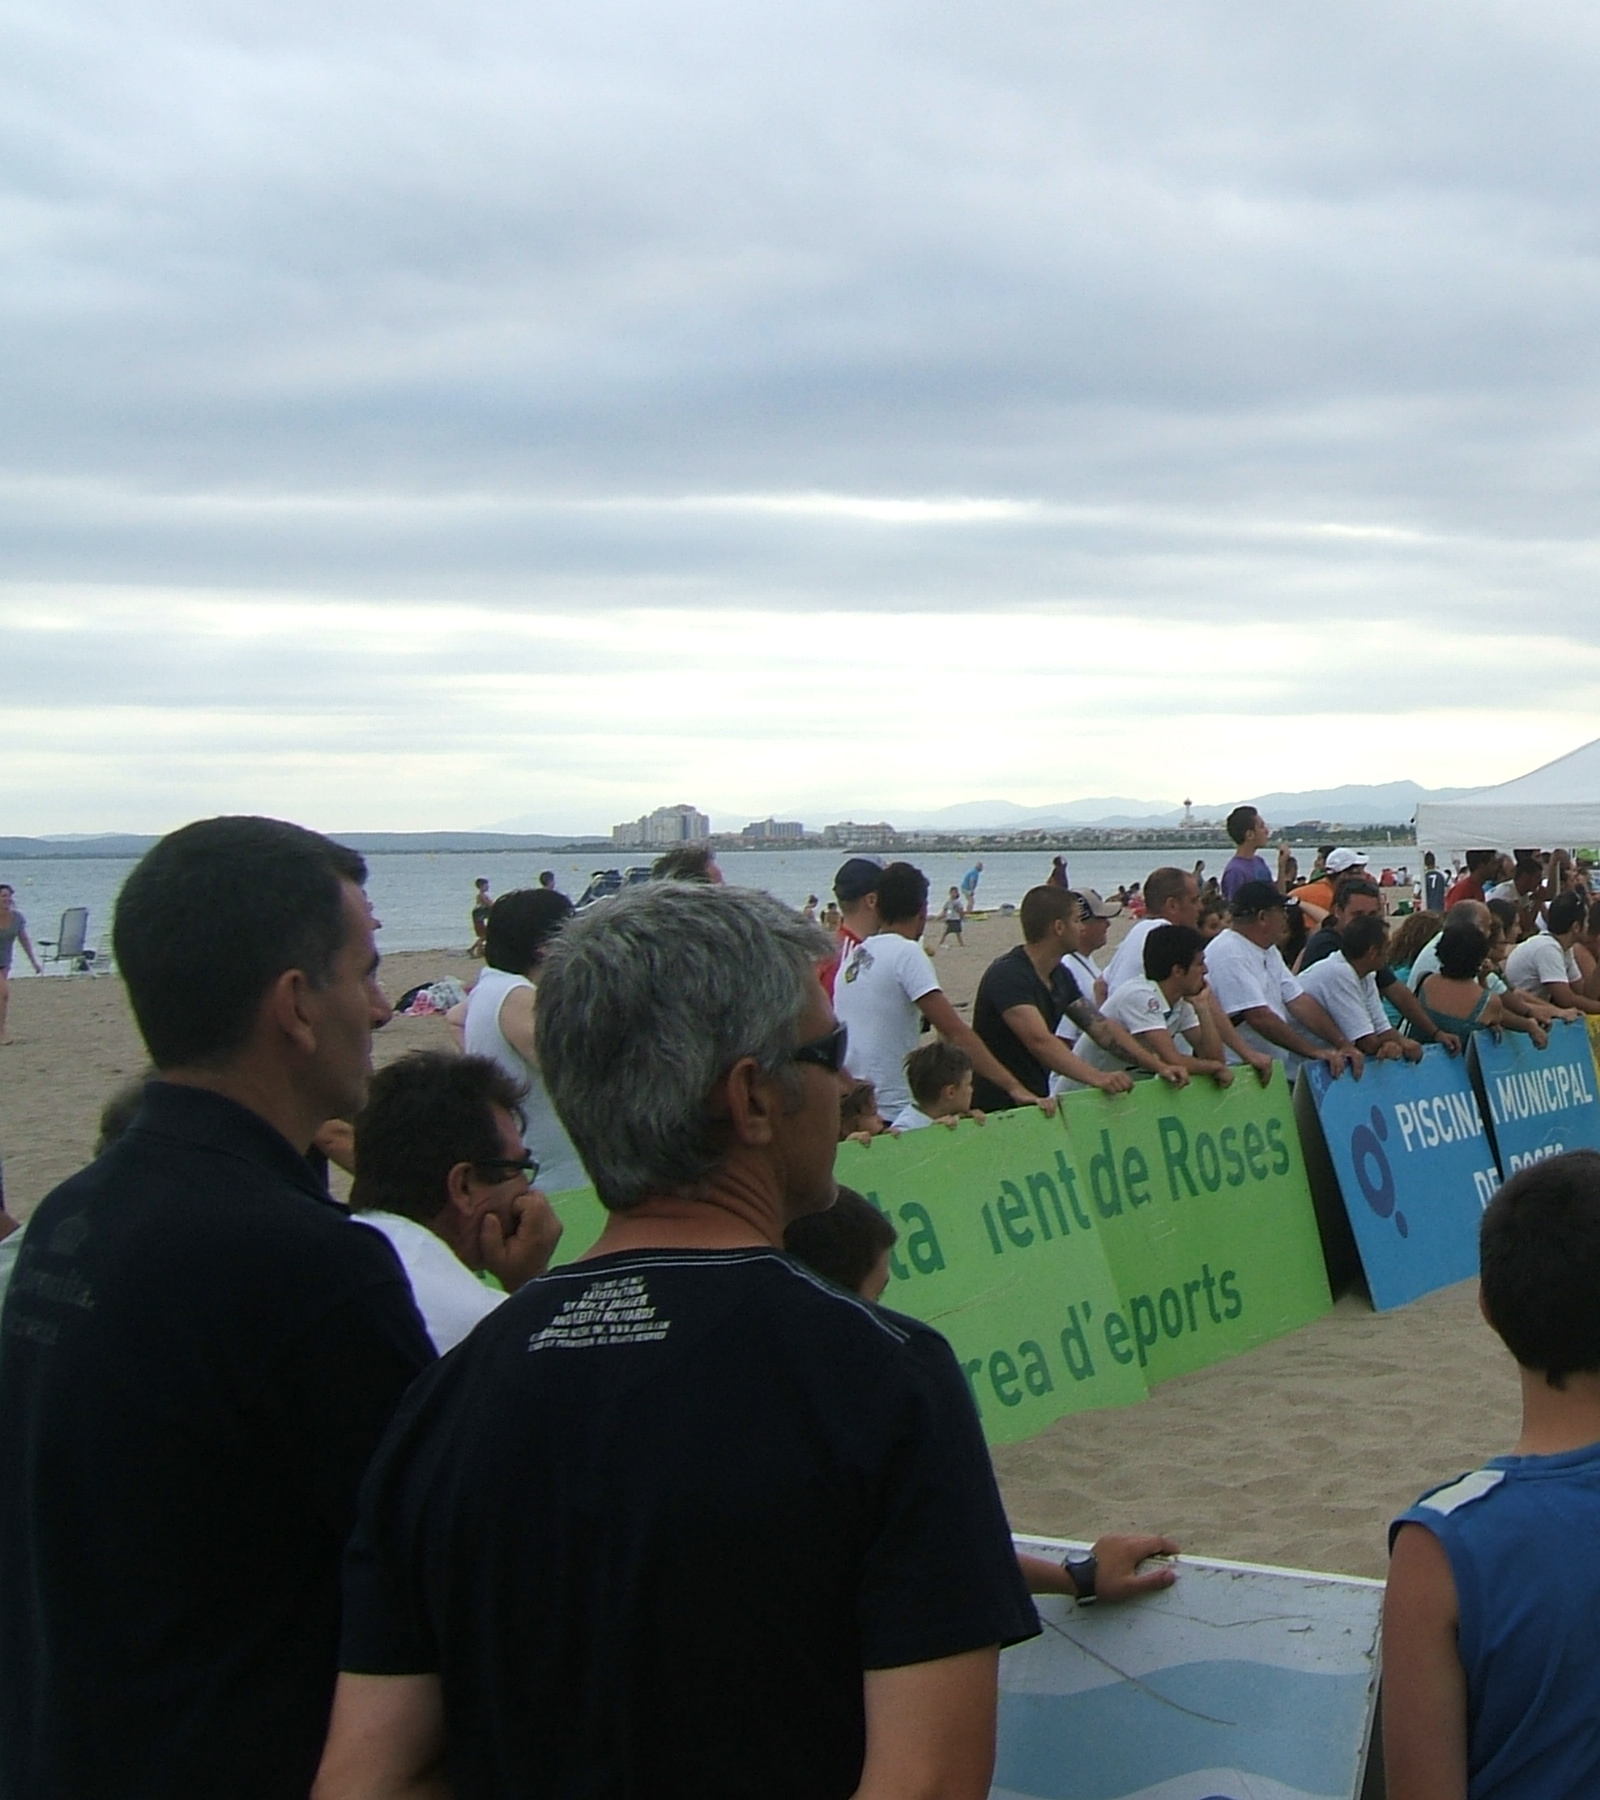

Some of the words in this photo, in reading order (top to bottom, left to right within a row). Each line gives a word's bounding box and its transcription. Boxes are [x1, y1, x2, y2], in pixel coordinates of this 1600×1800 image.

[1428, 874, 1437, 889] 7
[1394, 1089, 1500, 1152] PISCINA
[1496, 1062, 1593, 1123] MUNICIPAL
[1089, 1129, 1152, 1219] de
[1158, 1115, 1290, 1201] Roses
[961, 1340, 1054, 1418] rea
